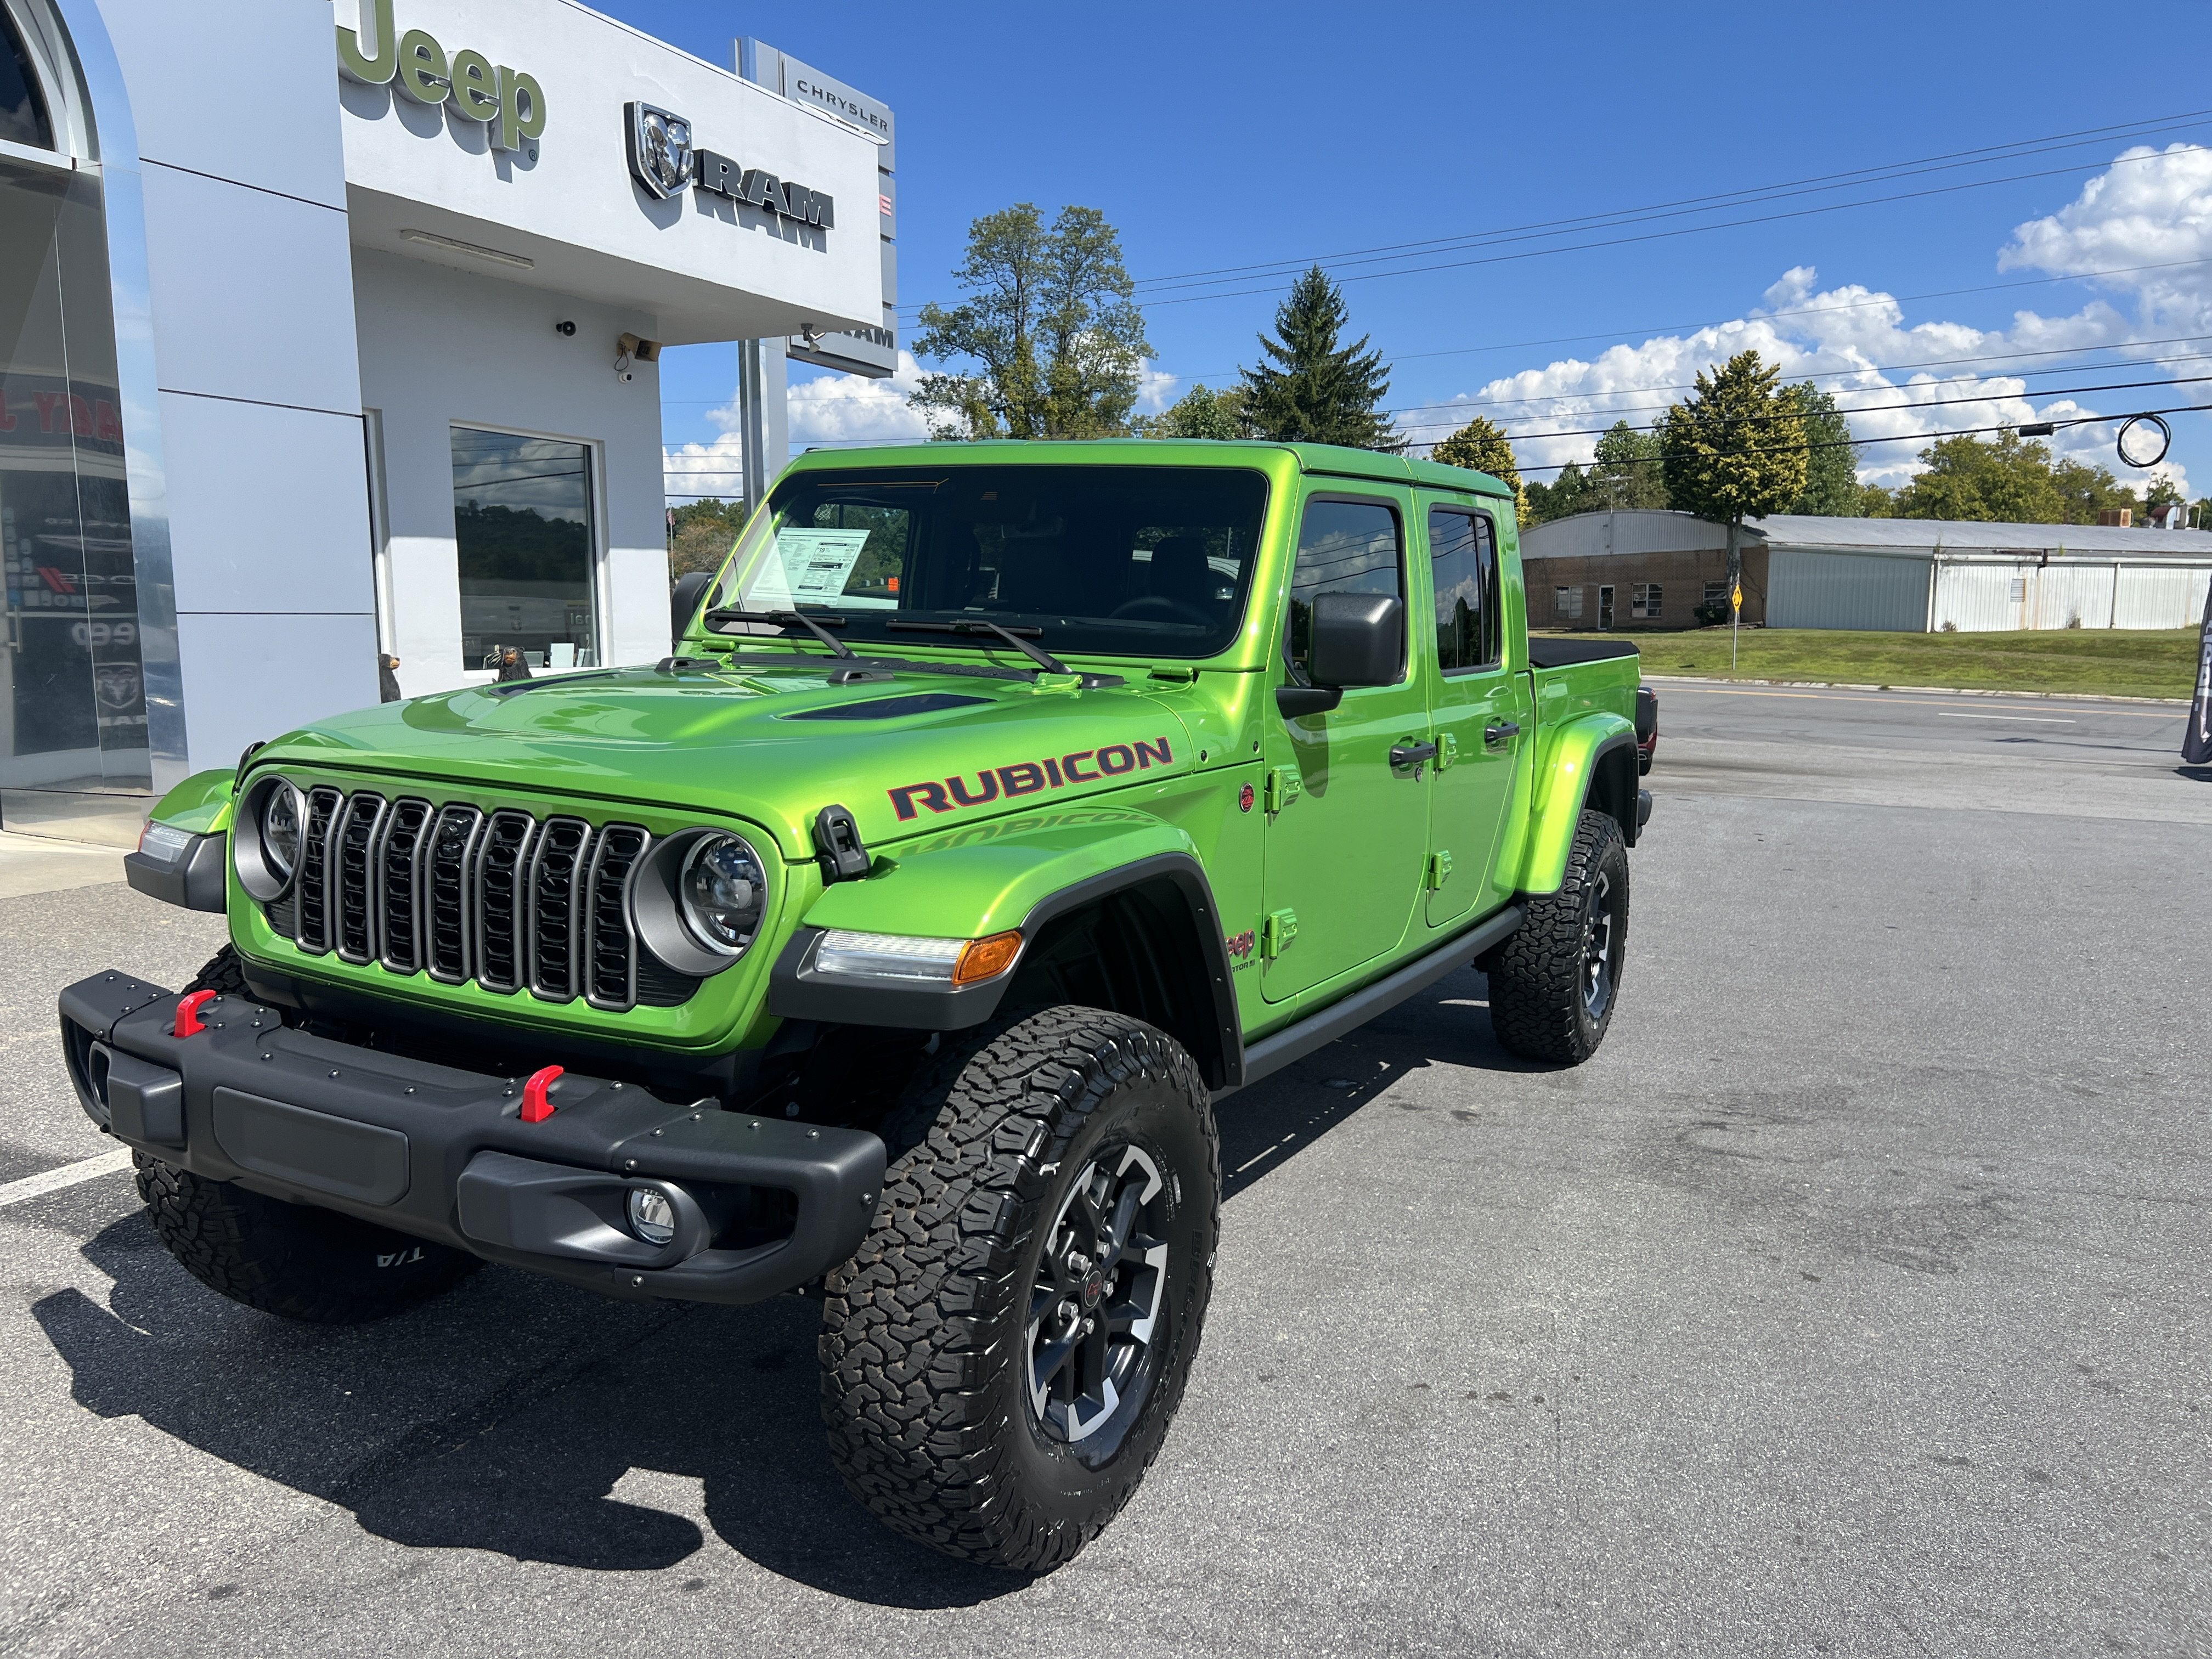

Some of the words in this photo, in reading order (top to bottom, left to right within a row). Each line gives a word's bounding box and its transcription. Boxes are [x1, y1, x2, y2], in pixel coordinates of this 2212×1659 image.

[336, 0, 548, 152] Jeep
[797, 80, 888, 133] CHRYSLER
[695, 148, 834, 230] RAM
[838, 329, 894, 349] AM
[887, 736, 1173, 822] RUBICON
[376, 1246, 425, 1267] T/A
